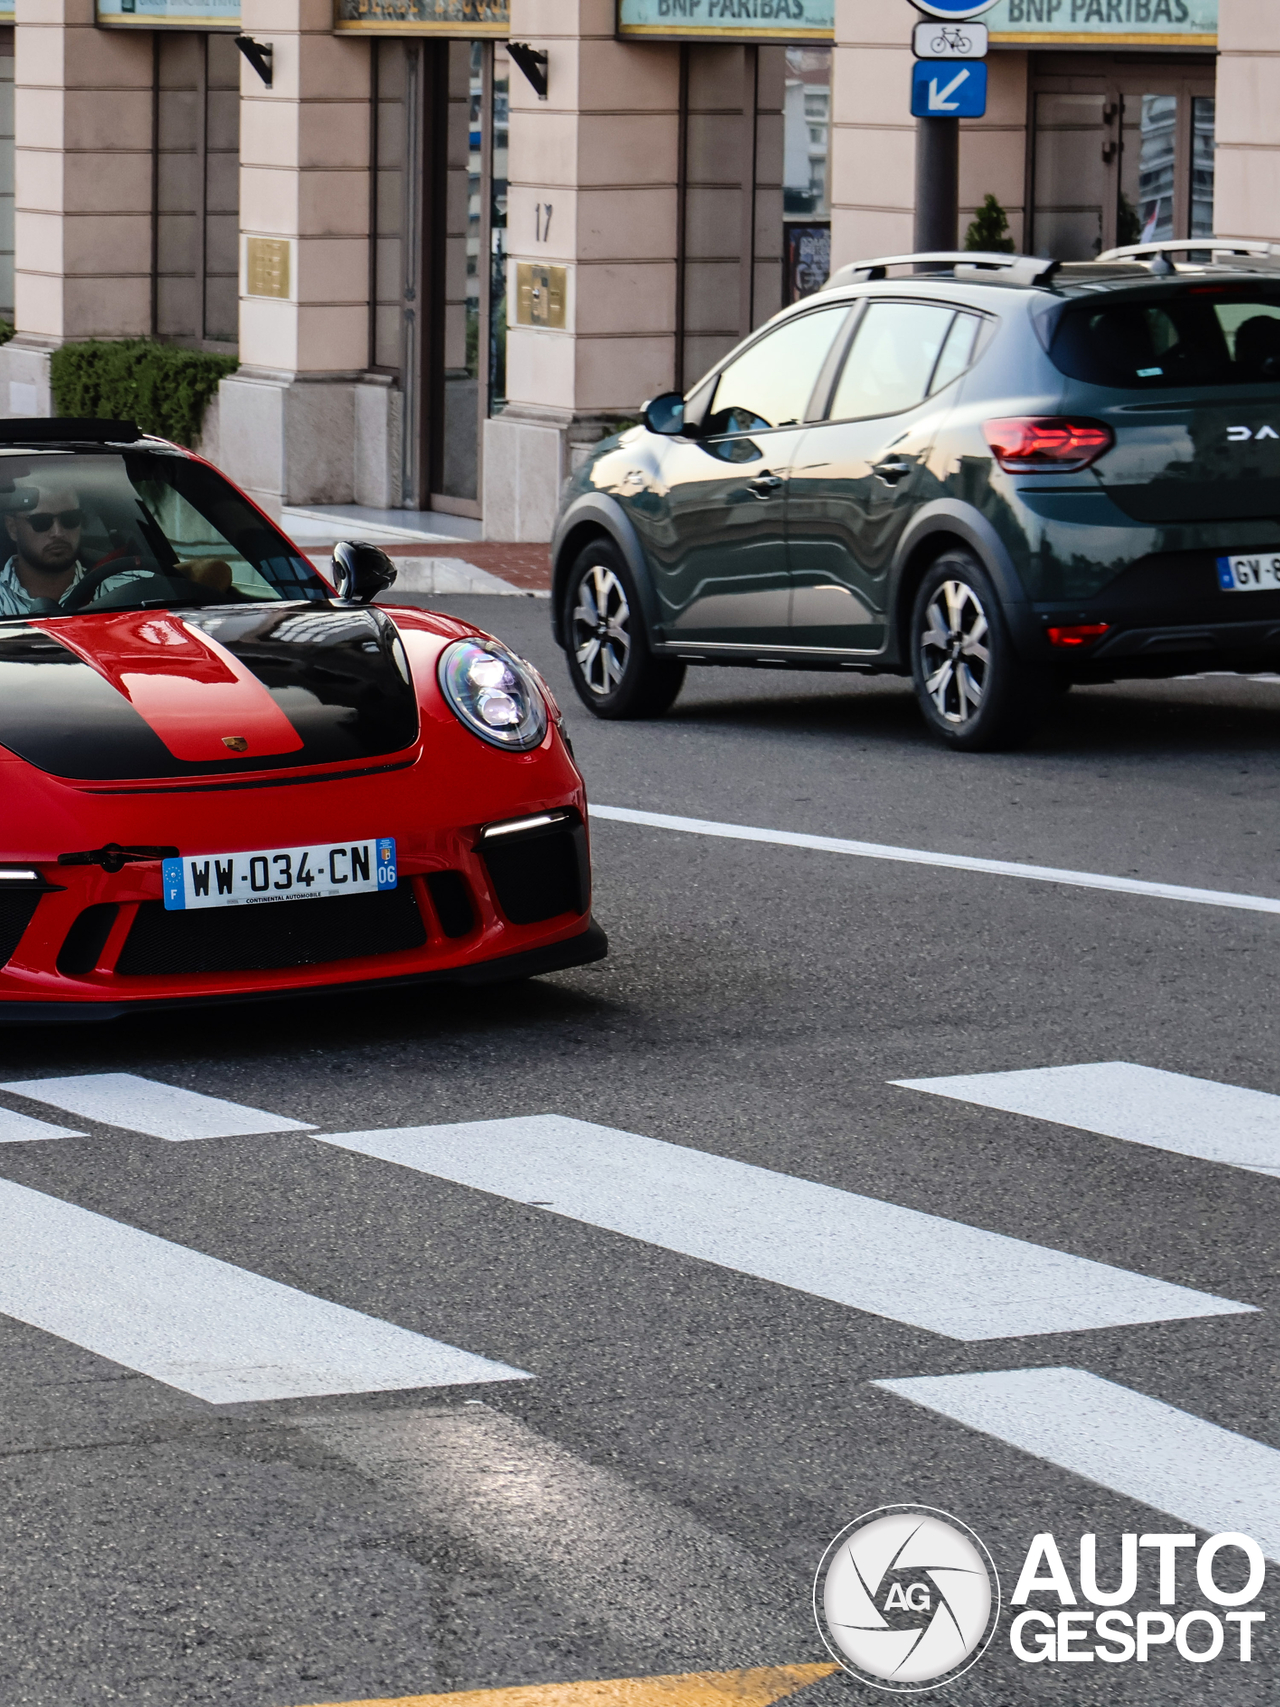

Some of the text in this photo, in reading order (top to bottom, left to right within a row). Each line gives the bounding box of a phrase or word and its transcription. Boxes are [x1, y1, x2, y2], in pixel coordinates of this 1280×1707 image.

[658, 0, 803, 19] BNP PARIBAS
[1009, 0, 1189, 23] BNP PARIBAS
[535, 203, 553, 242] 17
[191, 846, 370, 896] WW-034-CN
[378, 865, 396, 884] 06
[171, 889, 177, 900] F
[246, 895, 284, 904] CONTINENTAL
[286, 892, 321, 900] AUTOMOBILE
